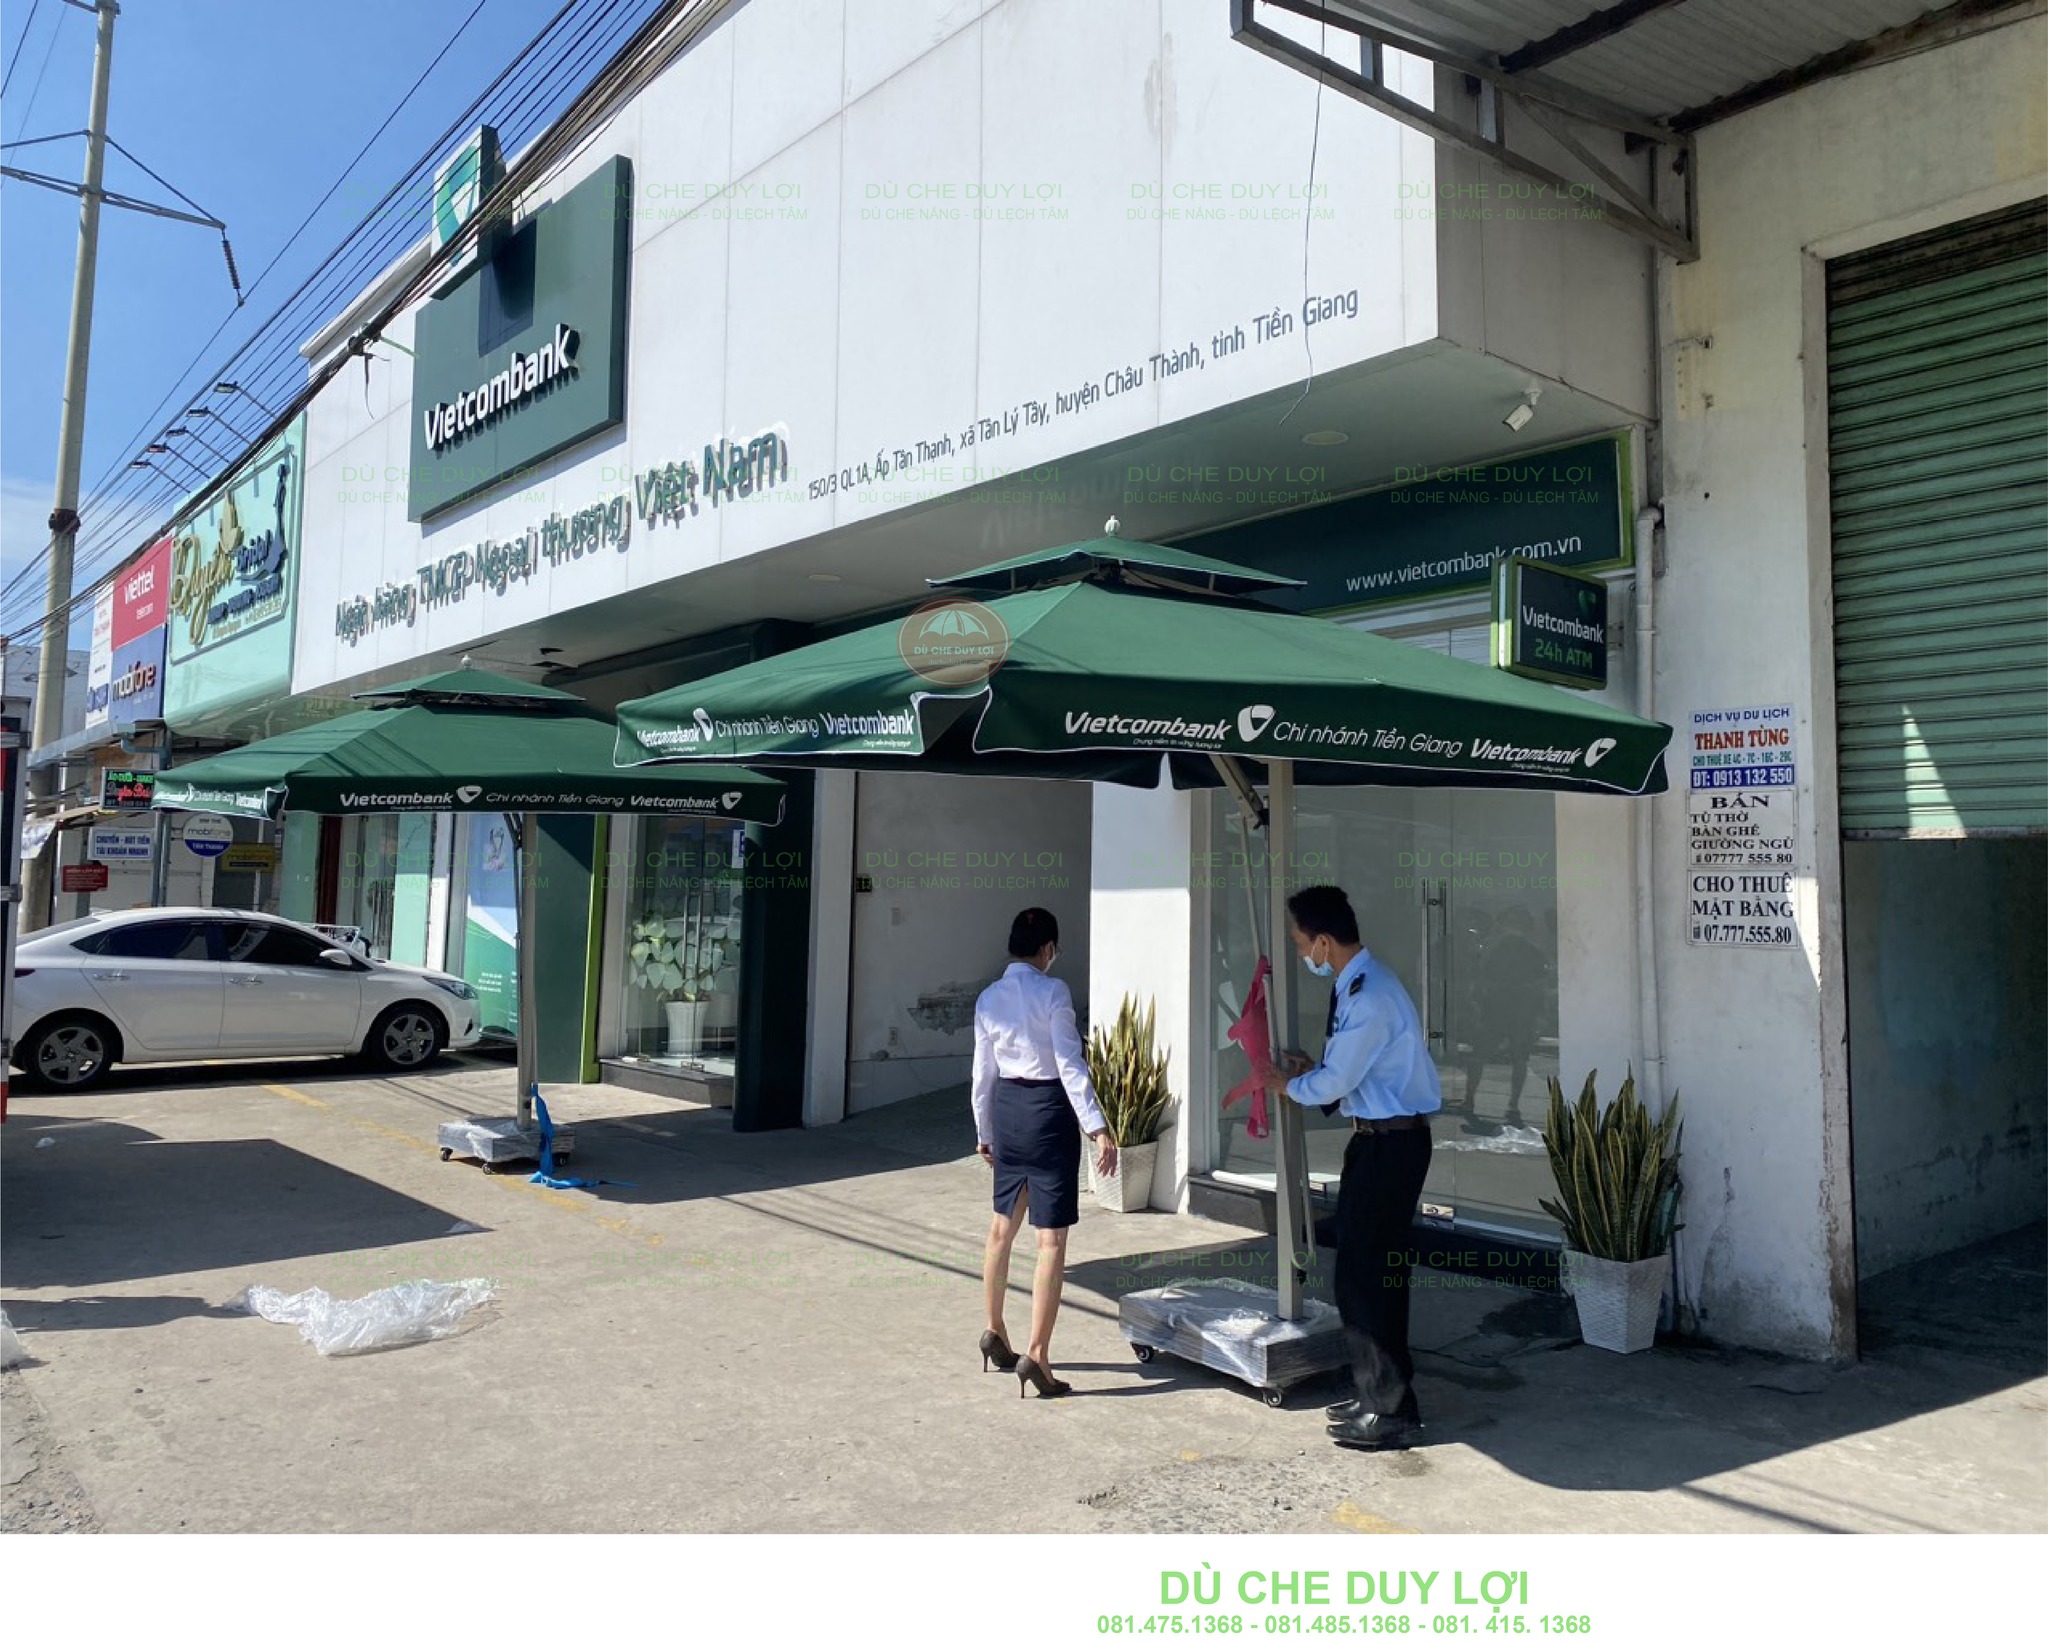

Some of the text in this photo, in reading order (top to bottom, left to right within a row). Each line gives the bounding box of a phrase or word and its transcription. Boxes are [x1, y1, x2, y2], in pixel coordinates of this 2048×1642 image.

[424, 323, 570, 450] Vietcombank
[808, 475, 838, 501] 150/3
[960, 425, 975, 450] xã
[978, 418, 1000, 442] Tân
[1004, 407, 1018, 435] Lý
[1056, 382, 1099, 415] huyện
[1105, 366, 1143, 398] Châu
[1212, 325, 1245, 359] tỉnh
[1253, 306, 1292, 345] Tiền
[1302, 289, 1358, 327] Giang
[703, 433, 786, 504] Nam
[1346, 536, 1582, 592] www.vietcombankcom.vn
[1522, 604, 1604, 644] Vietcombank
[1535, 638, 1593, 669] 24h ATM
[820, 710, 914, 735] Vietcombank
[1744, 710, 1759, 720] DU
[1065, 711, 1232, 740] Vietcombank
[1274, 722, 1308, 742] Chi
[1308, 725, 1368, 746] nhánh
[1410, 732, 1463, 758] Giang
[1470, 738, 1582, 765] Vietcombank
[1695, 731, 1744, 750] THANH
[1713, 770, 1742, 785] 0913
[1745, 768, 1767, 785] 132
[1770, 767, 1792, 784] 550
[340, 792, 453, 807] Vietcombank
[586, 795, 625, 807] Giang
[630, 795, 718, 809] Vietcombank
[1704, 853, 1792, 863] 07777 555 80
[1693, 871, 1793, 893] CHO THUÊ
[1704, 924, 1792, 944] 07.777.555.80
